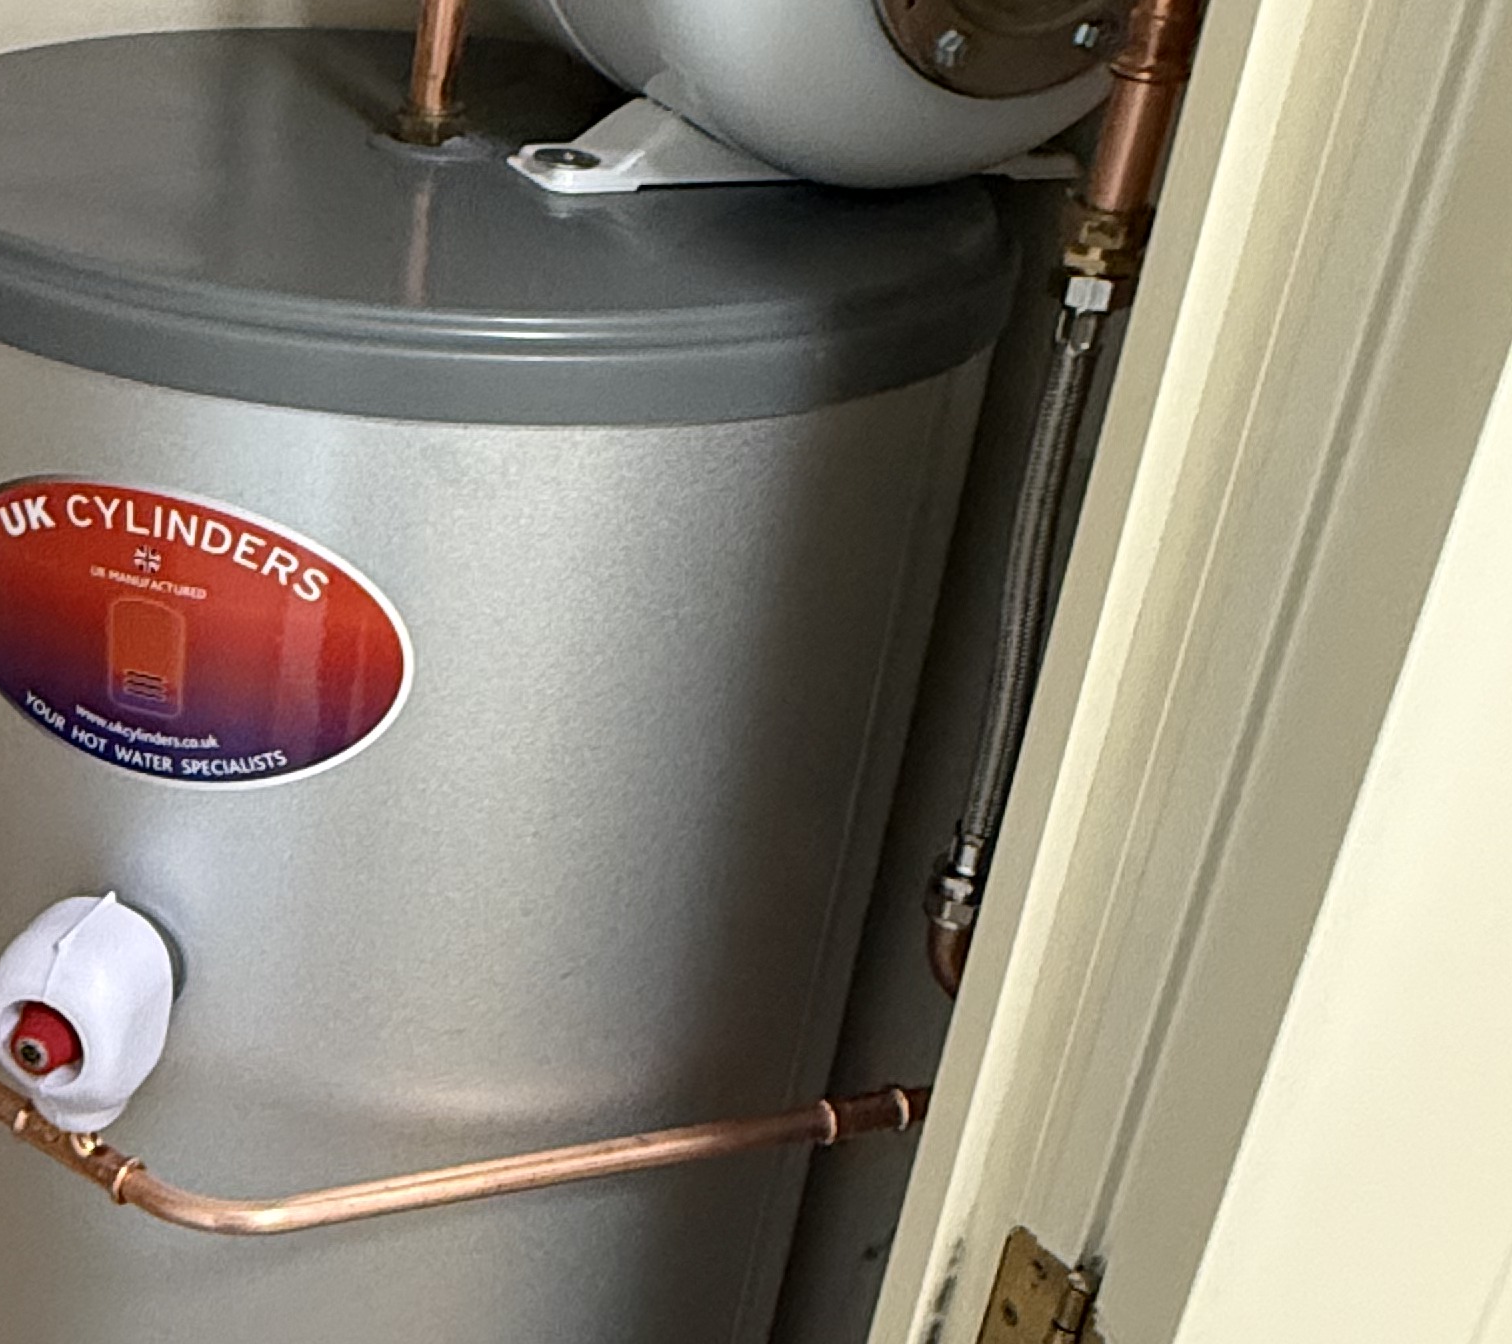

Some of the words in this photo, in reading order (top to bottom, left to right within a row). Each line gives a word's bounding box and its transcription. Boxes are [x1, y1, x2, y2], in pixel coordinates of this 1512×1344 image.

[65, 494, 330, 602] CYLINDERS
[90, 565, 106, 577] UK
[108, 570, 208, 600] MANUFACTURED
[25, 690, 66, 732] YOUR
[71, 724, 108, 754] HOT
[114, 743, 173, 773] WATER
[180, 749, 288, 777] SPECIALISTS
[74, 704, 220, 749] www.ukcylinders.co.uk
